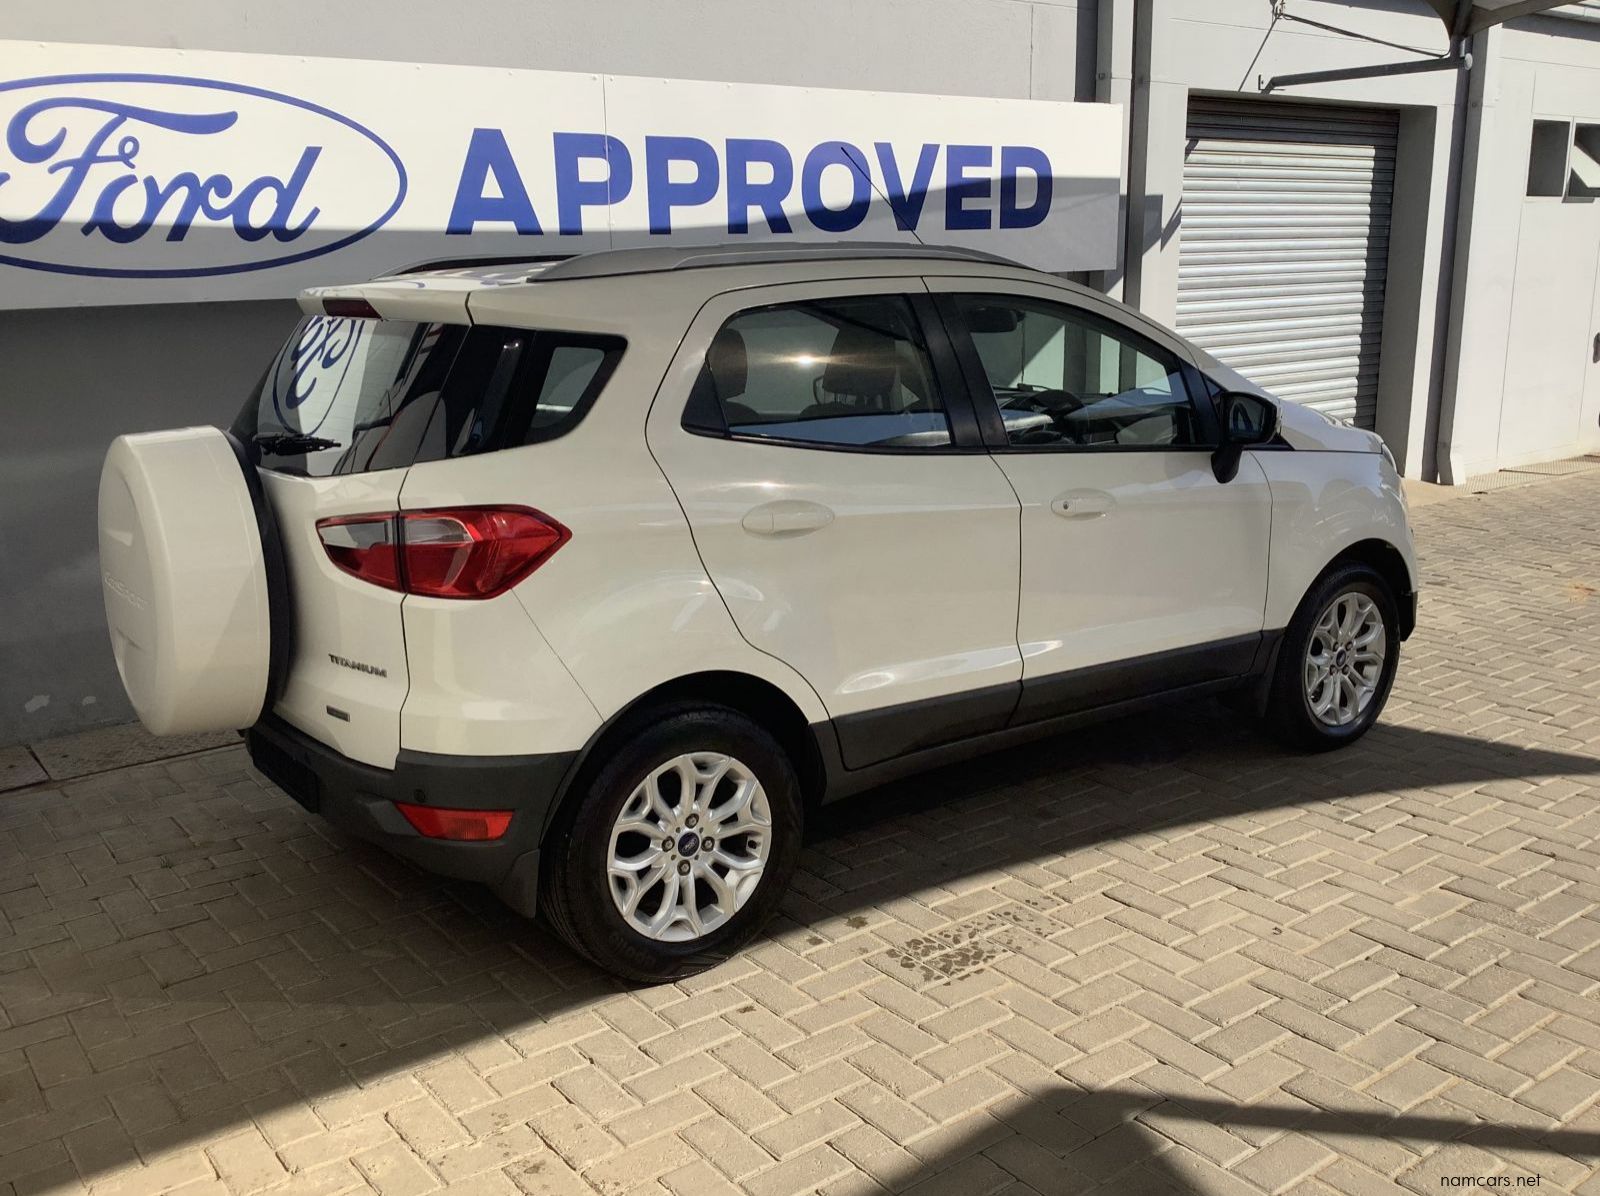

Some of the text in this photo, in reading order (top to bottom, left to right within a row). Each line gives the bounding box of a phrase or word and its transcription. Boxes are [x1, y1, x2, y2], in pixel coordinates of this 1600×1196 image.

[0, 97, 1053, 243] Ford APPROVED
[328, 653, 388, 678] TITANIUM
